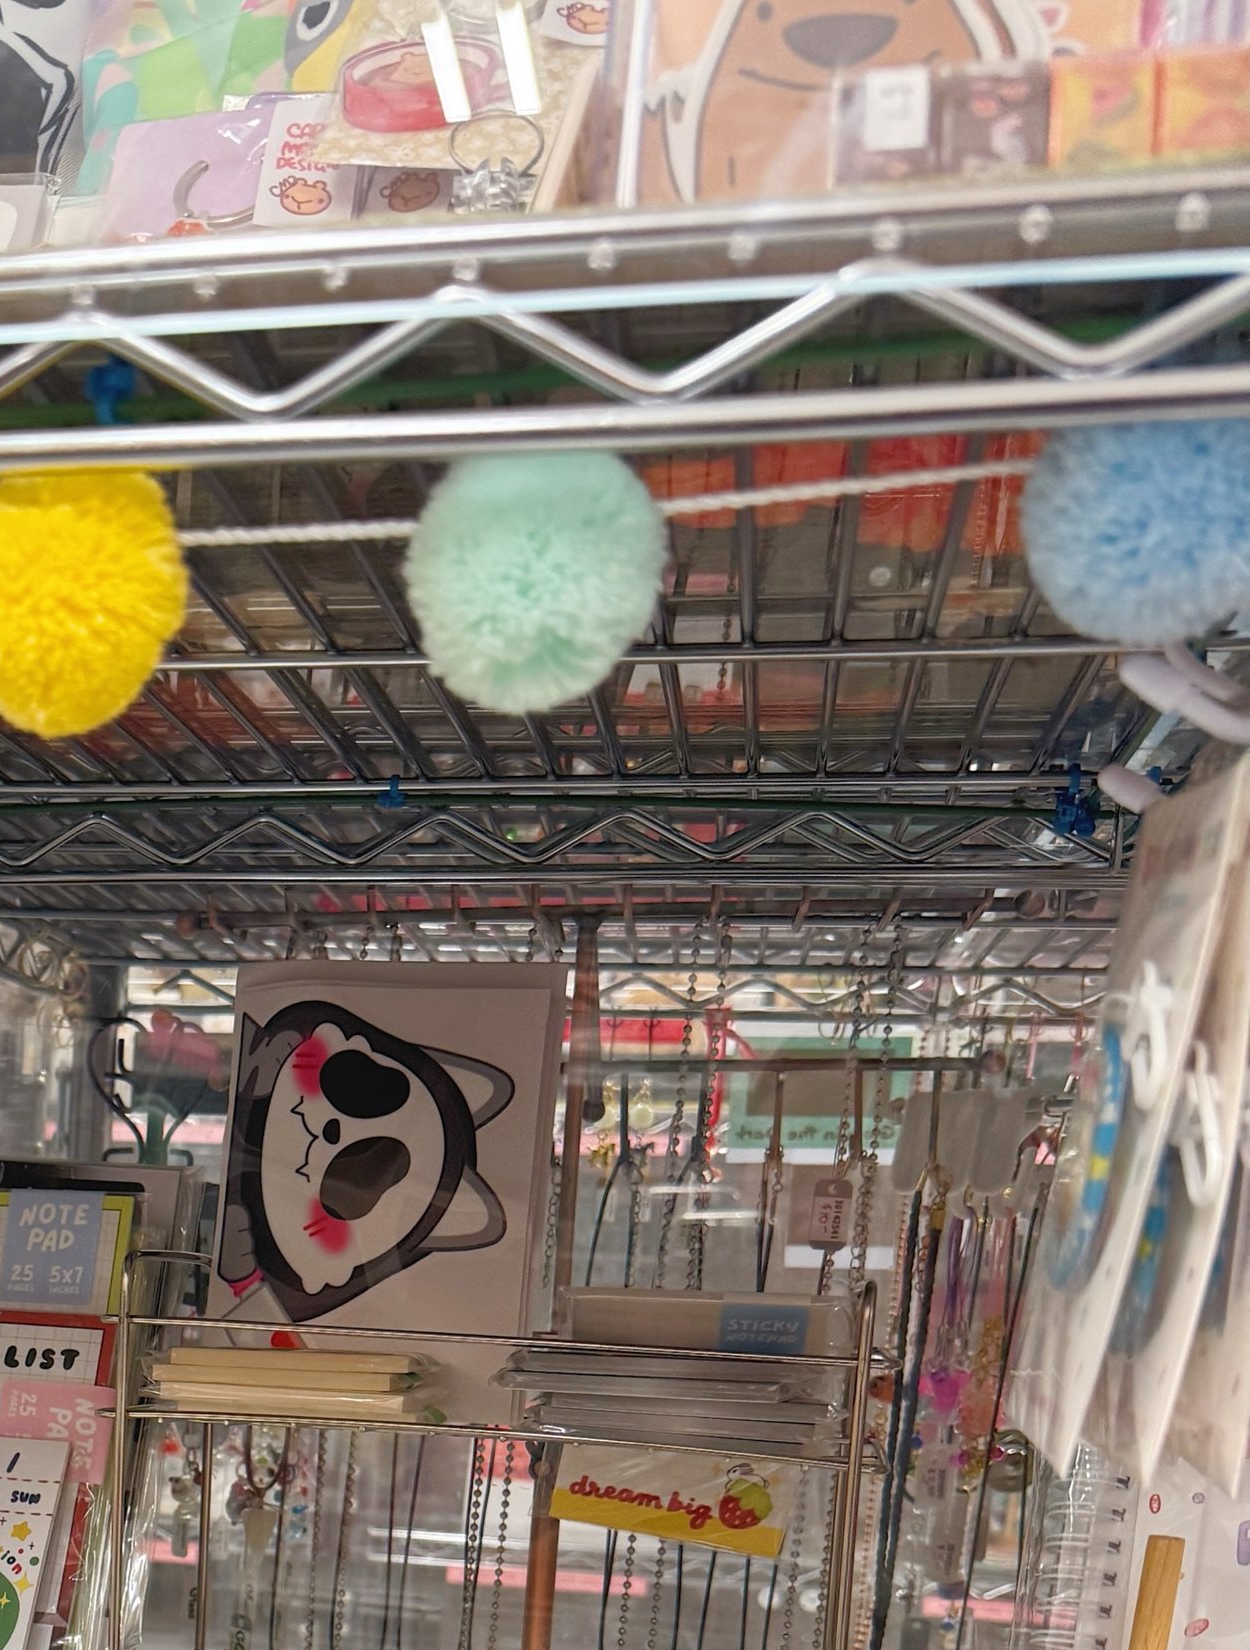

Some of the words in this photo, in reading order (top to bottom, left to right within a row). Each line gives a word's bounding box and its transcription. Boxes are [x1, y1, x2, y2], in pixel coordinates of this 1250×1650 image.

[19, 1203, 90, 1227] NOTE
[26, 1228, 75, 1252] PAD
[10, 1264, 34, 1282] 25
[727, 1318, 800, 1333] STICKY
[3, 1345, 80, 1370] LIST
[19, 1391, 38, 1417] 25
[9, 1489, 42, 1505] SUN
[568, 1474, 663, 1510] dream
[665, 1490, 714, 1530] big
